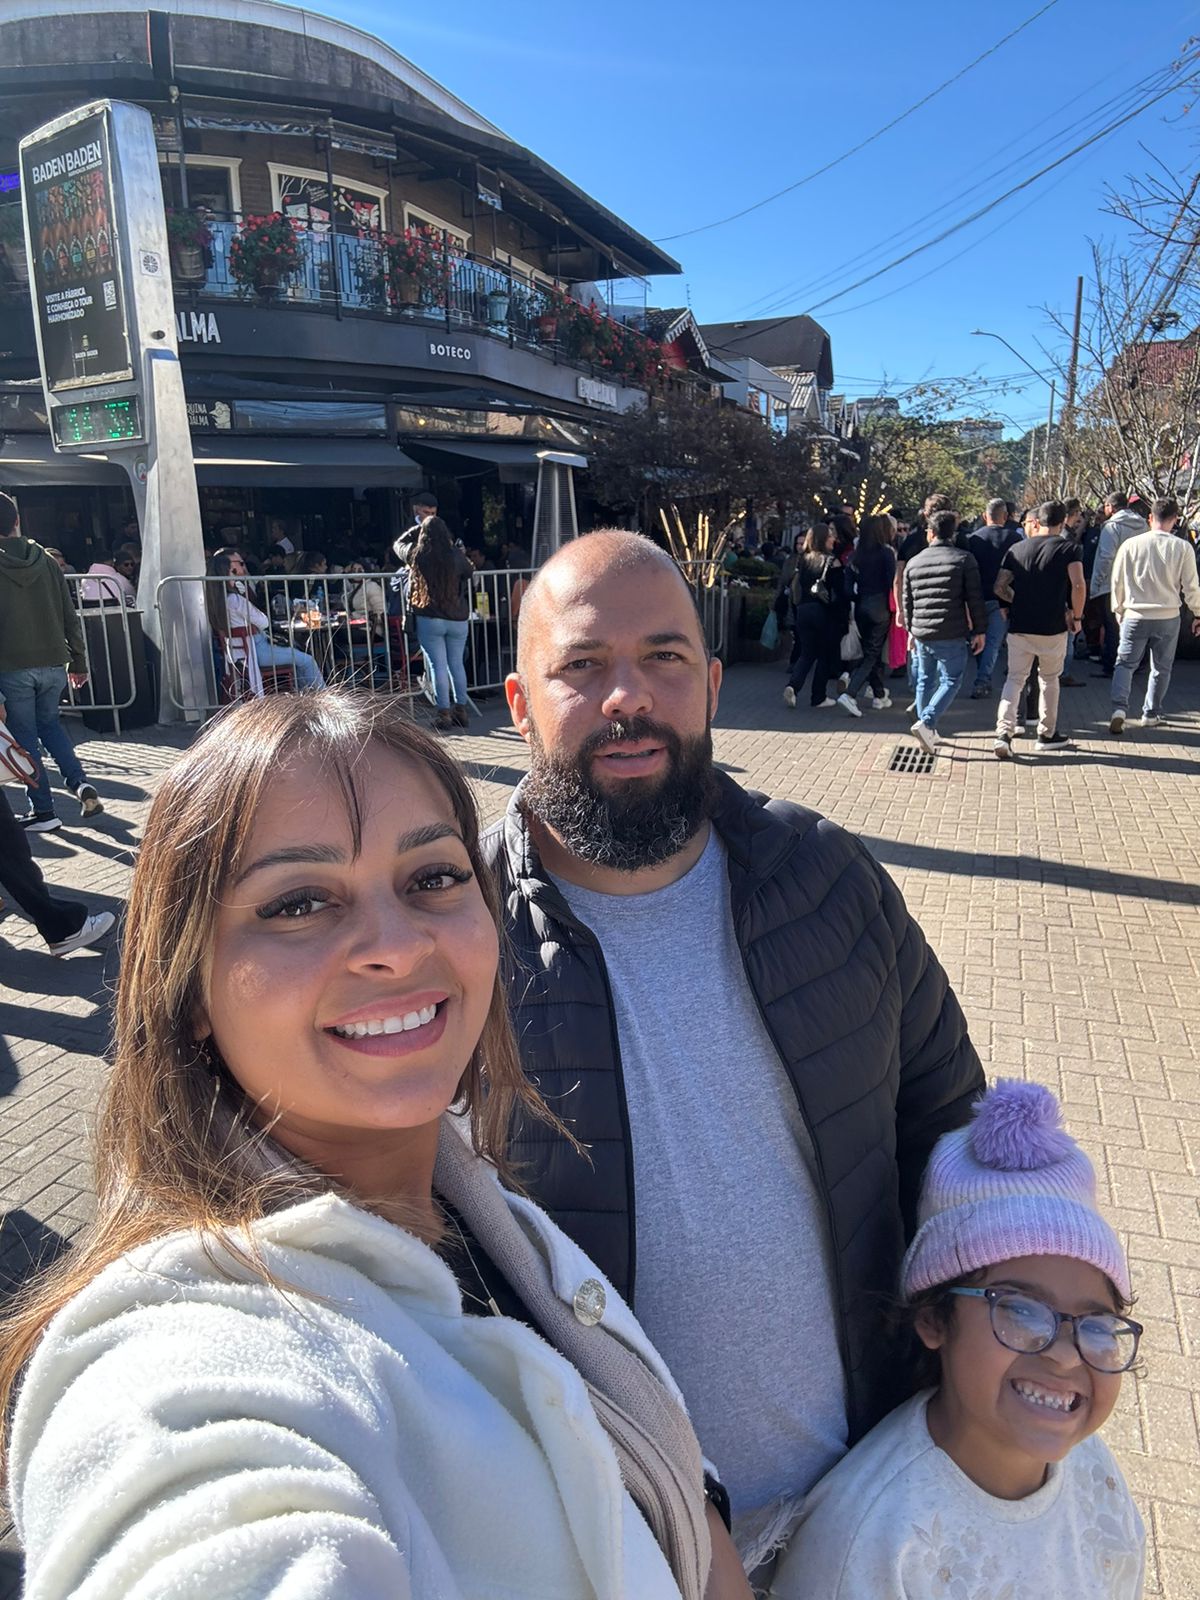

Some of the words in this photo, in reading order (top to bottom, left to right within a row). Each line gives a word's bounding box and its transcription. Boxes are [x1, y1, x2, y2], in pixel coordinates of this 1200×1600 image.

[32, 155, 66, 184] BADEN
[65, 140, 102, 171] BADEN
[74, 299, 79, 307] O
[79, 296, 93, 306] TOUR
[430, 343, 471, 360] BOTECO
